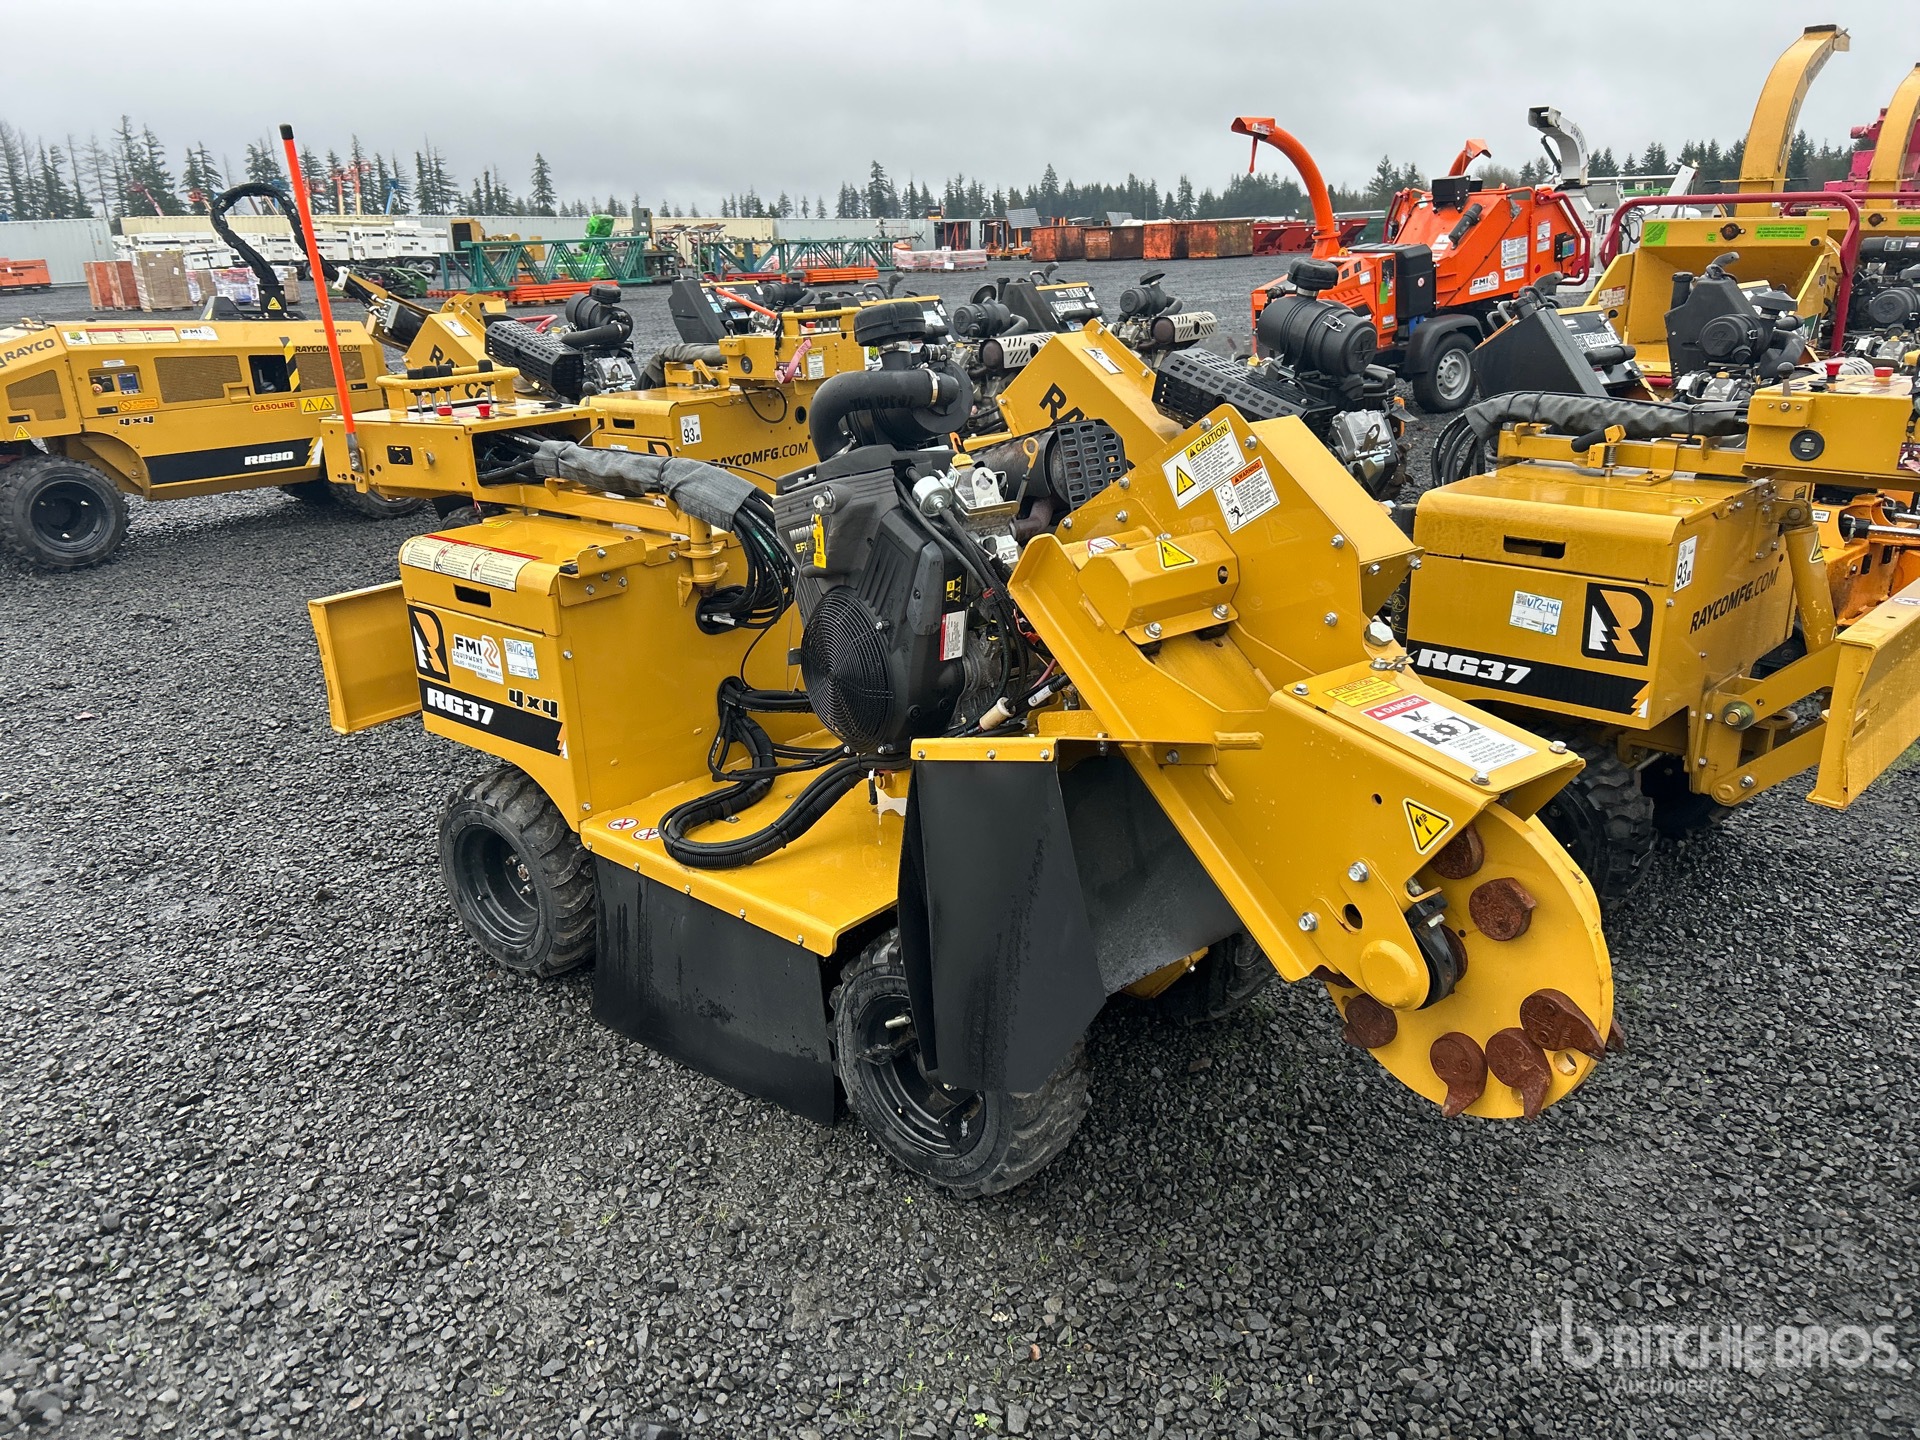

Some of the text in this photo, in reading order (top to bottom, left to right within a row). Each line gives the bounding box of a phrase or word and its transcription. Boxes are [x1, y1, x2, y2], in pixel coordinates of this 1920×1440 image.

[4, 338, 55, 361] RAYCO
[295, 344, 360, 352] RAYCOM.COM
[253, 401, 296, 412] GASOLINE
[683, 428, 695, 443] 93
[1195, 423, 1228, 452] CAUTION
[243, 451, 294, 466] RG80
[1239, 462, 1260, 480] WARNING
[1676, 560, 1688, 588] 93
[1689, 566, 1779, 635] RAYCOMFG.COM
[455, 636, 482, 656] FMI
[452, 650, 483, 665] EQUIPMENT
[1417, 649, 1531, 685] RG37
[427, 687, 494, 725] RG37
[508, 689, 558, 719] 4x4
[1382, 697, 1424, 714] DANGER
